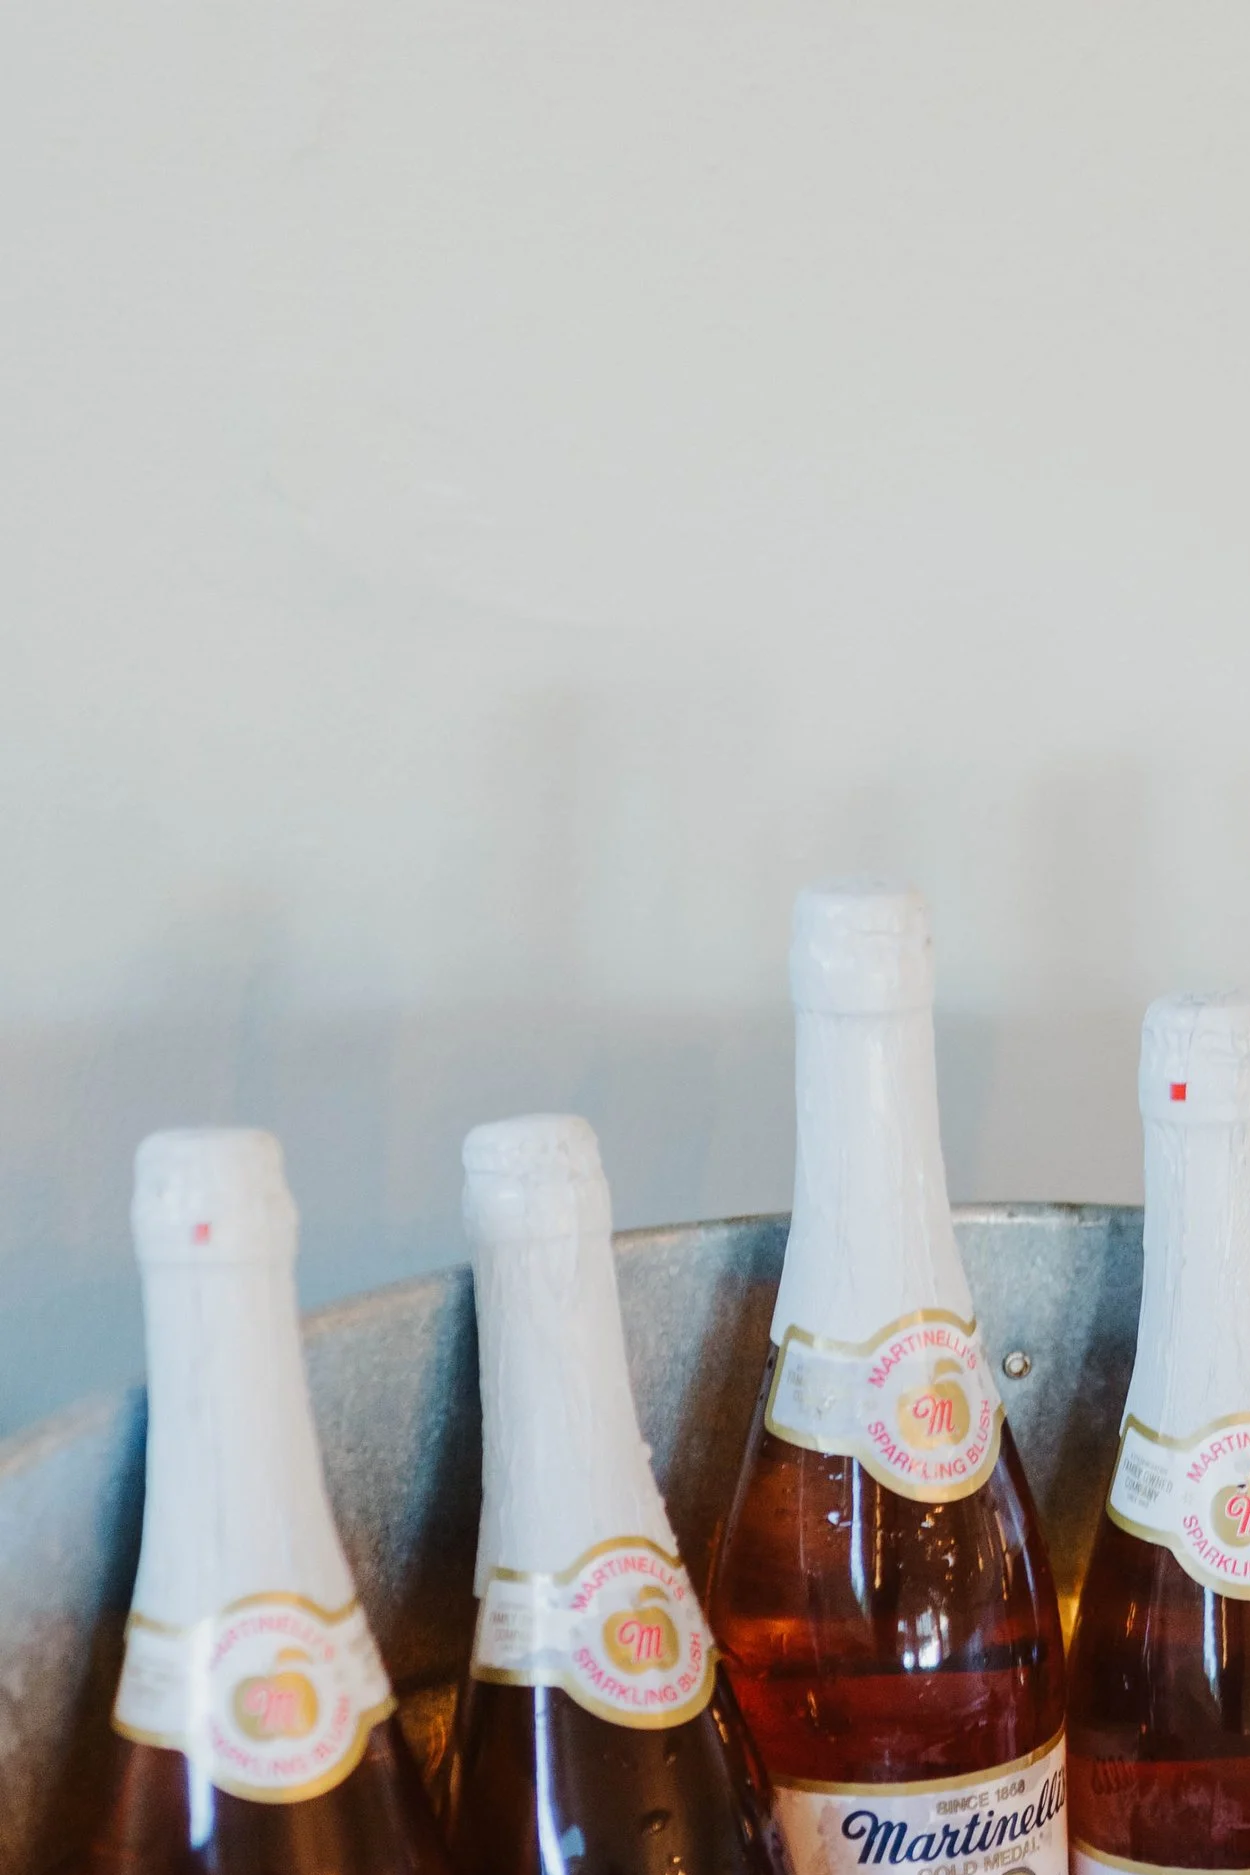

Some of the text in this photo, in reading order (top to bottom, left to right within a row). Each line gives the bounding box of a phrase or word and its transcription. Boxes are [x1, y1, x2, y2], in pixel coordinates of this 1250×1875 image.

[868, 1329, 977, 1388] MARTINELLI'S
[868, 1399, 990, 1480] SPARKLING BLUSH
[573, 1646, 677, 1704] SPARKLING
[936, 1779, 1025, 1815] SINCE 1868
